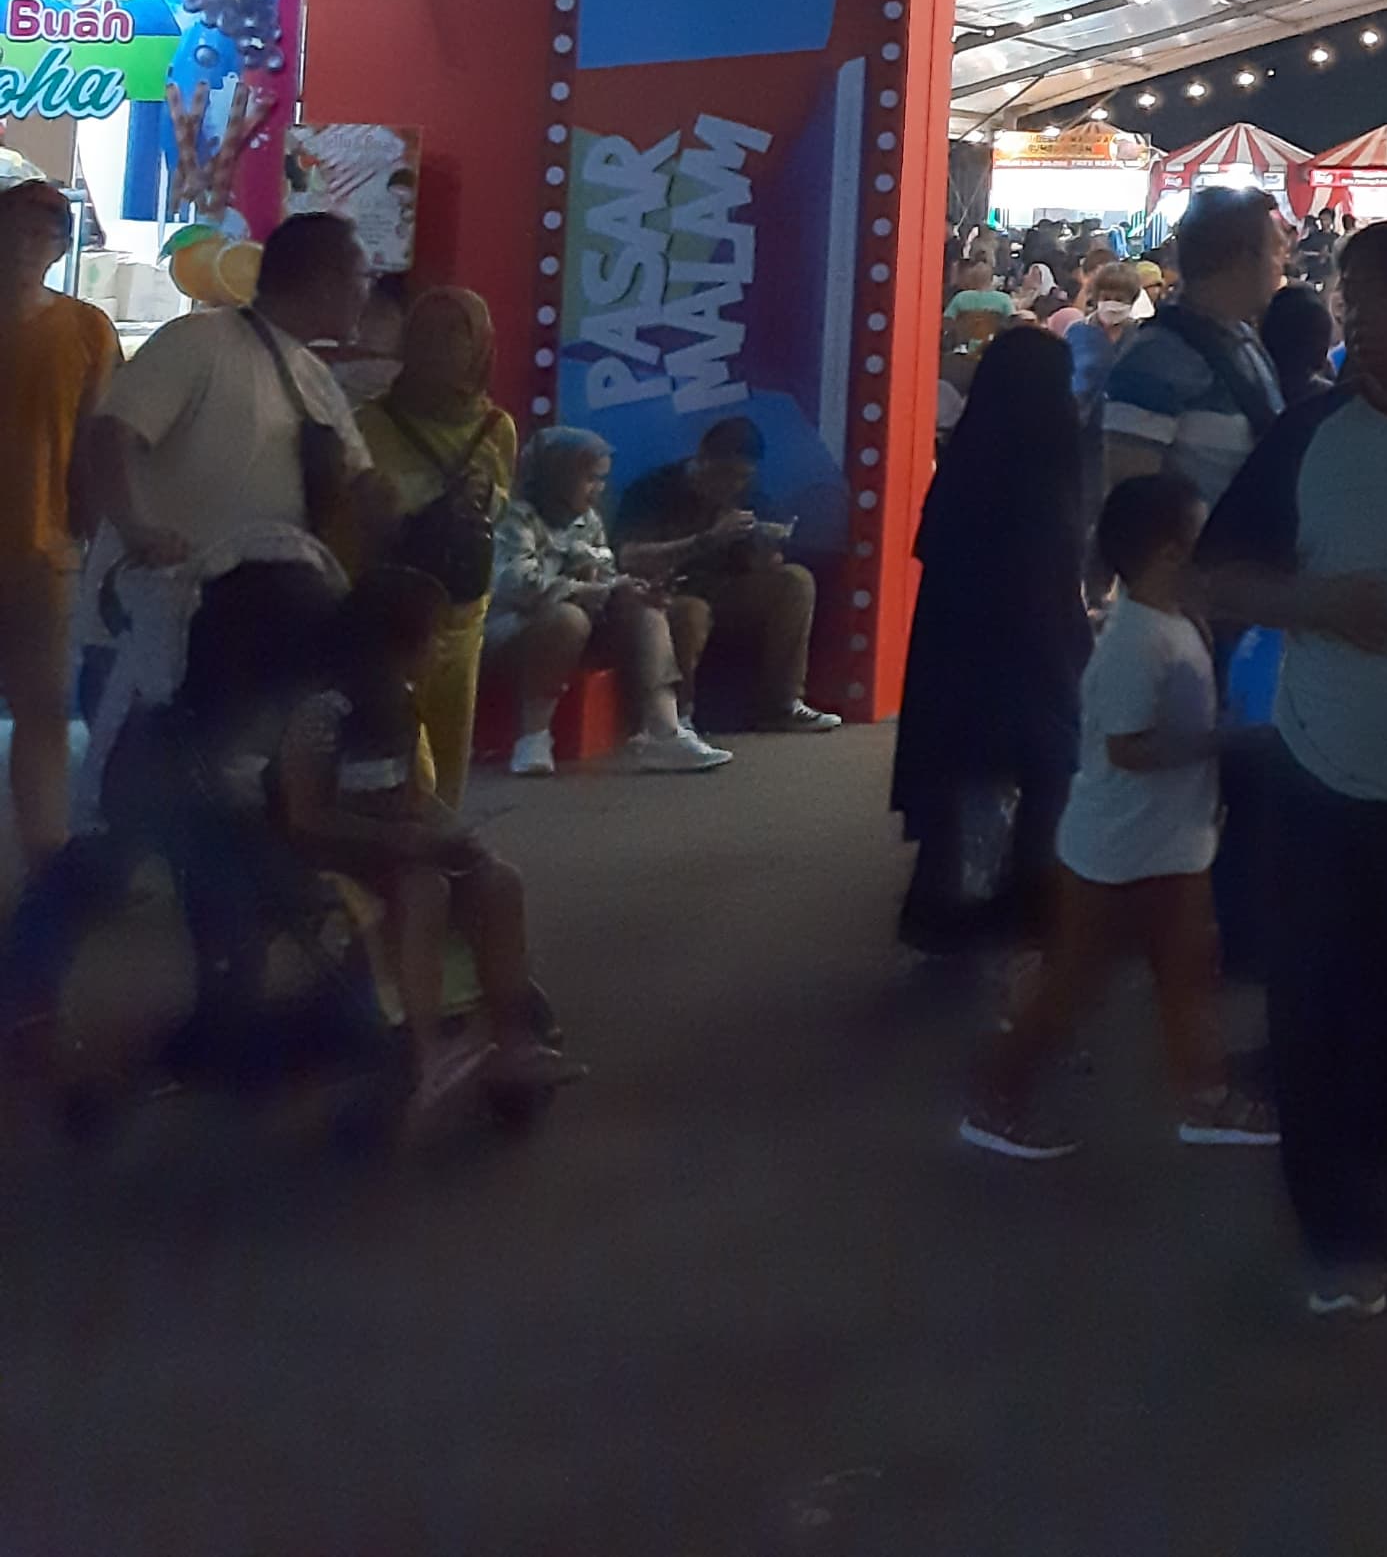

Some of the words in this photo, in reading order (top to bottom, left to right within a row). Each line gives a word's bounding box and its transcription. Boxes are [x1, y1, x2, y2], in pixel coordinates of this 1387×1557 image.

[0, 45, 126, 116] oha
[580, 129, 682, 410] PASAR
[663, 113, 773, 414] MALAM
